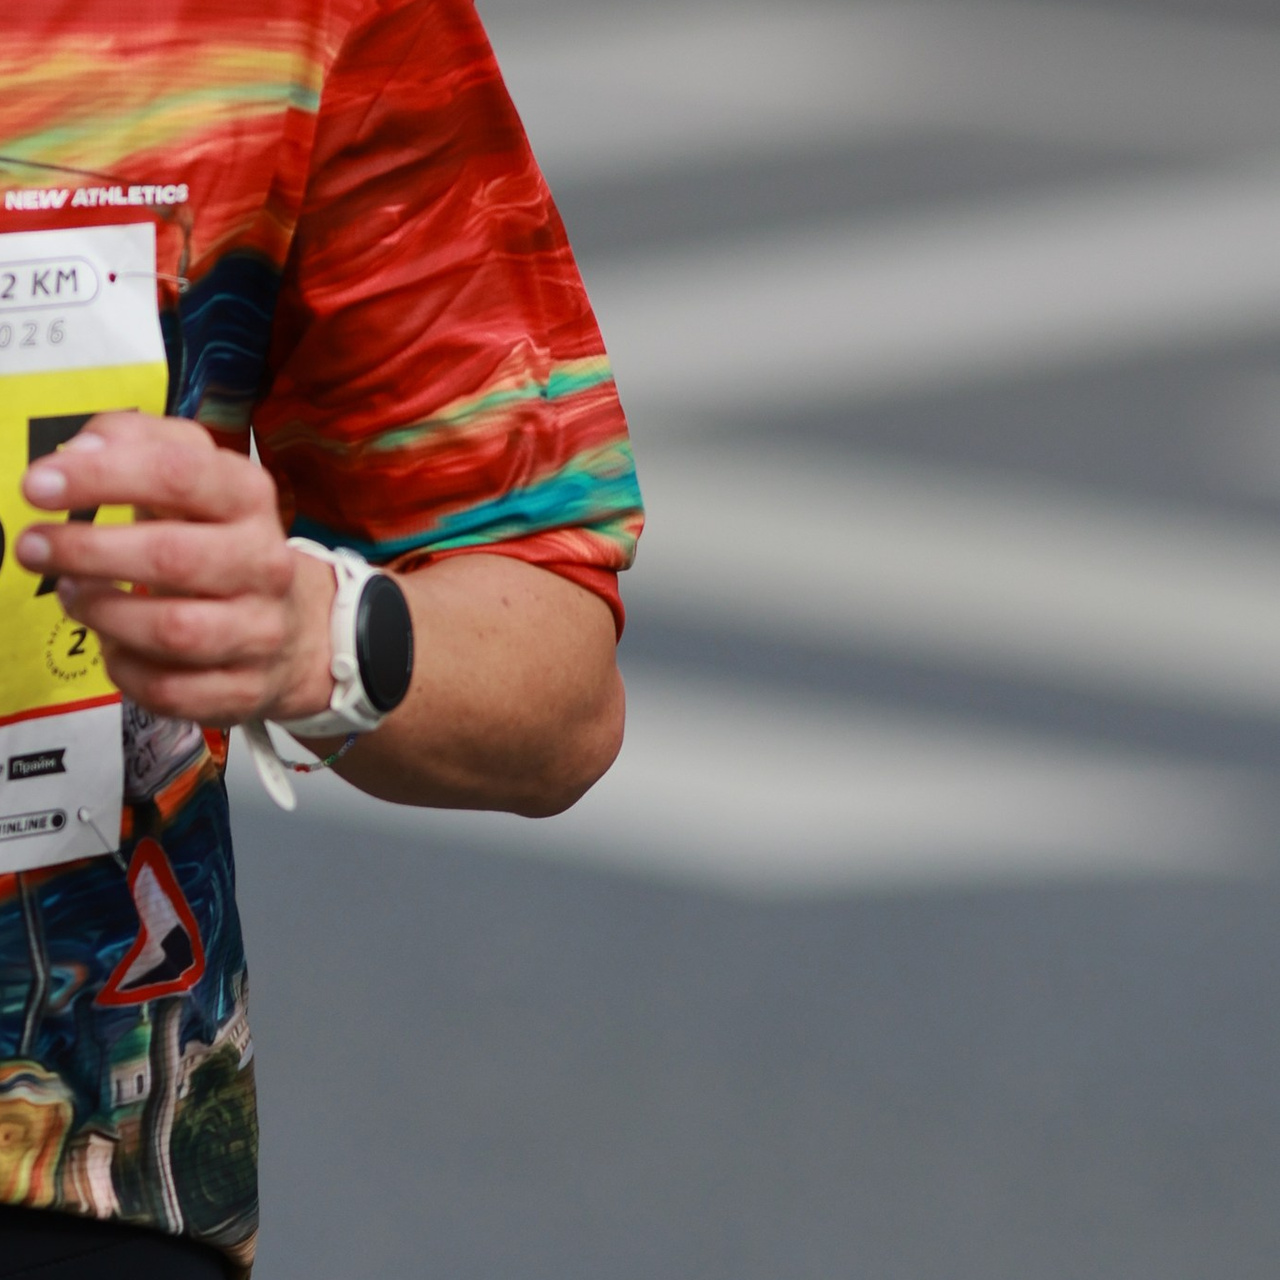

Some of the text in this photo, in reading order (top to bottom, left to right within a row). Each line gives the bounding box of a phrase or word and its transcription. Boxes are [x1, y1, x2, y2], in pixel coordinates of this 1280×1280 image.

[5, 184, 189, 210] NEW ATHLETICS
[12, 756, 57, 775] Прайм
